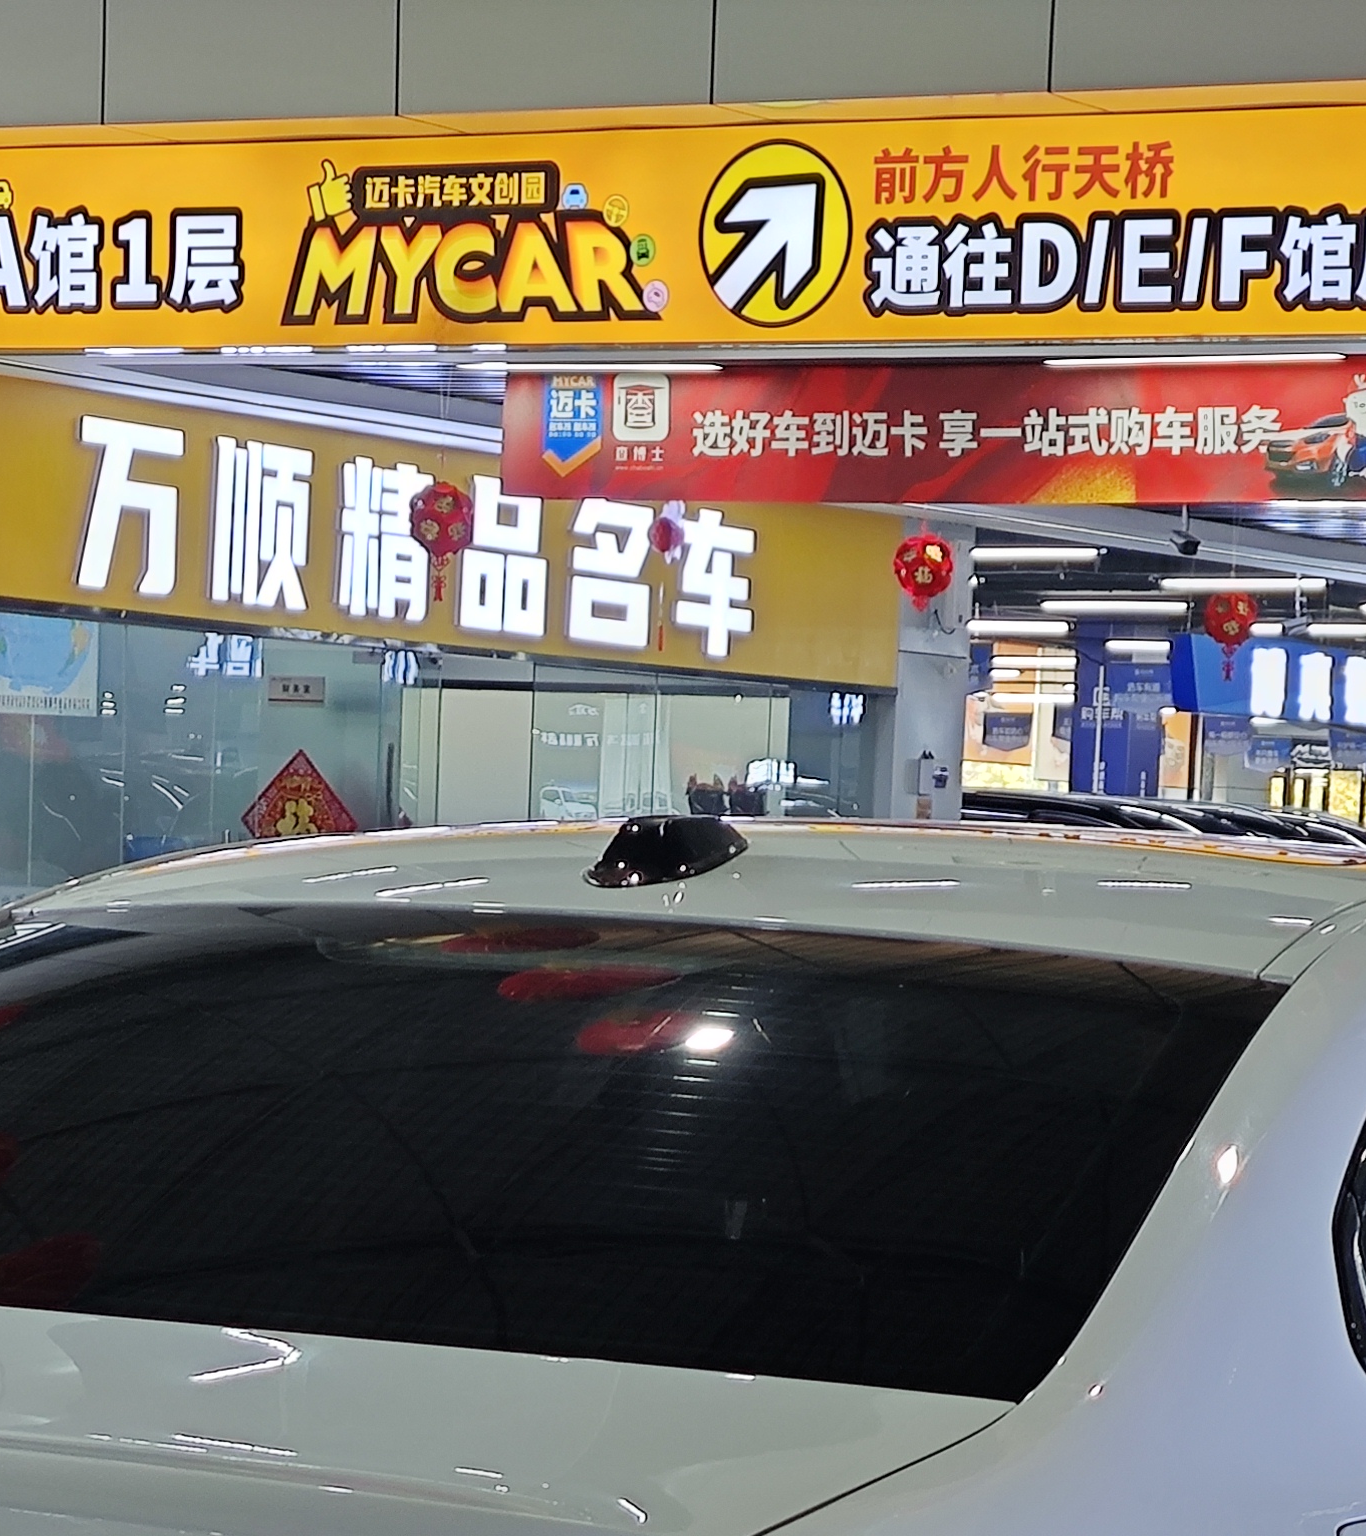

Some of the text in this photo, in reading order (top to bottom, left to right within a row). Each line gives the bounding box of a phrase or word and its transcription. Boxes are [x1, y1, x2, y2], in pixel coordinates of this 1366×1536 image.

[363, 170, 547, 210] 迈卡汽车文创园
[873, 141, 1175, 204] 前方人行天桥
[290, 218, 645, 320] MYCAR
[549, 389, 598, 419] 迈卡
[552, 375, 597, 388] MYCAR
[691, 404, 1284, 458] 选好车到迈卡 享一站式购车服务
[73, 412, 758, 661] 万顺精品名车
